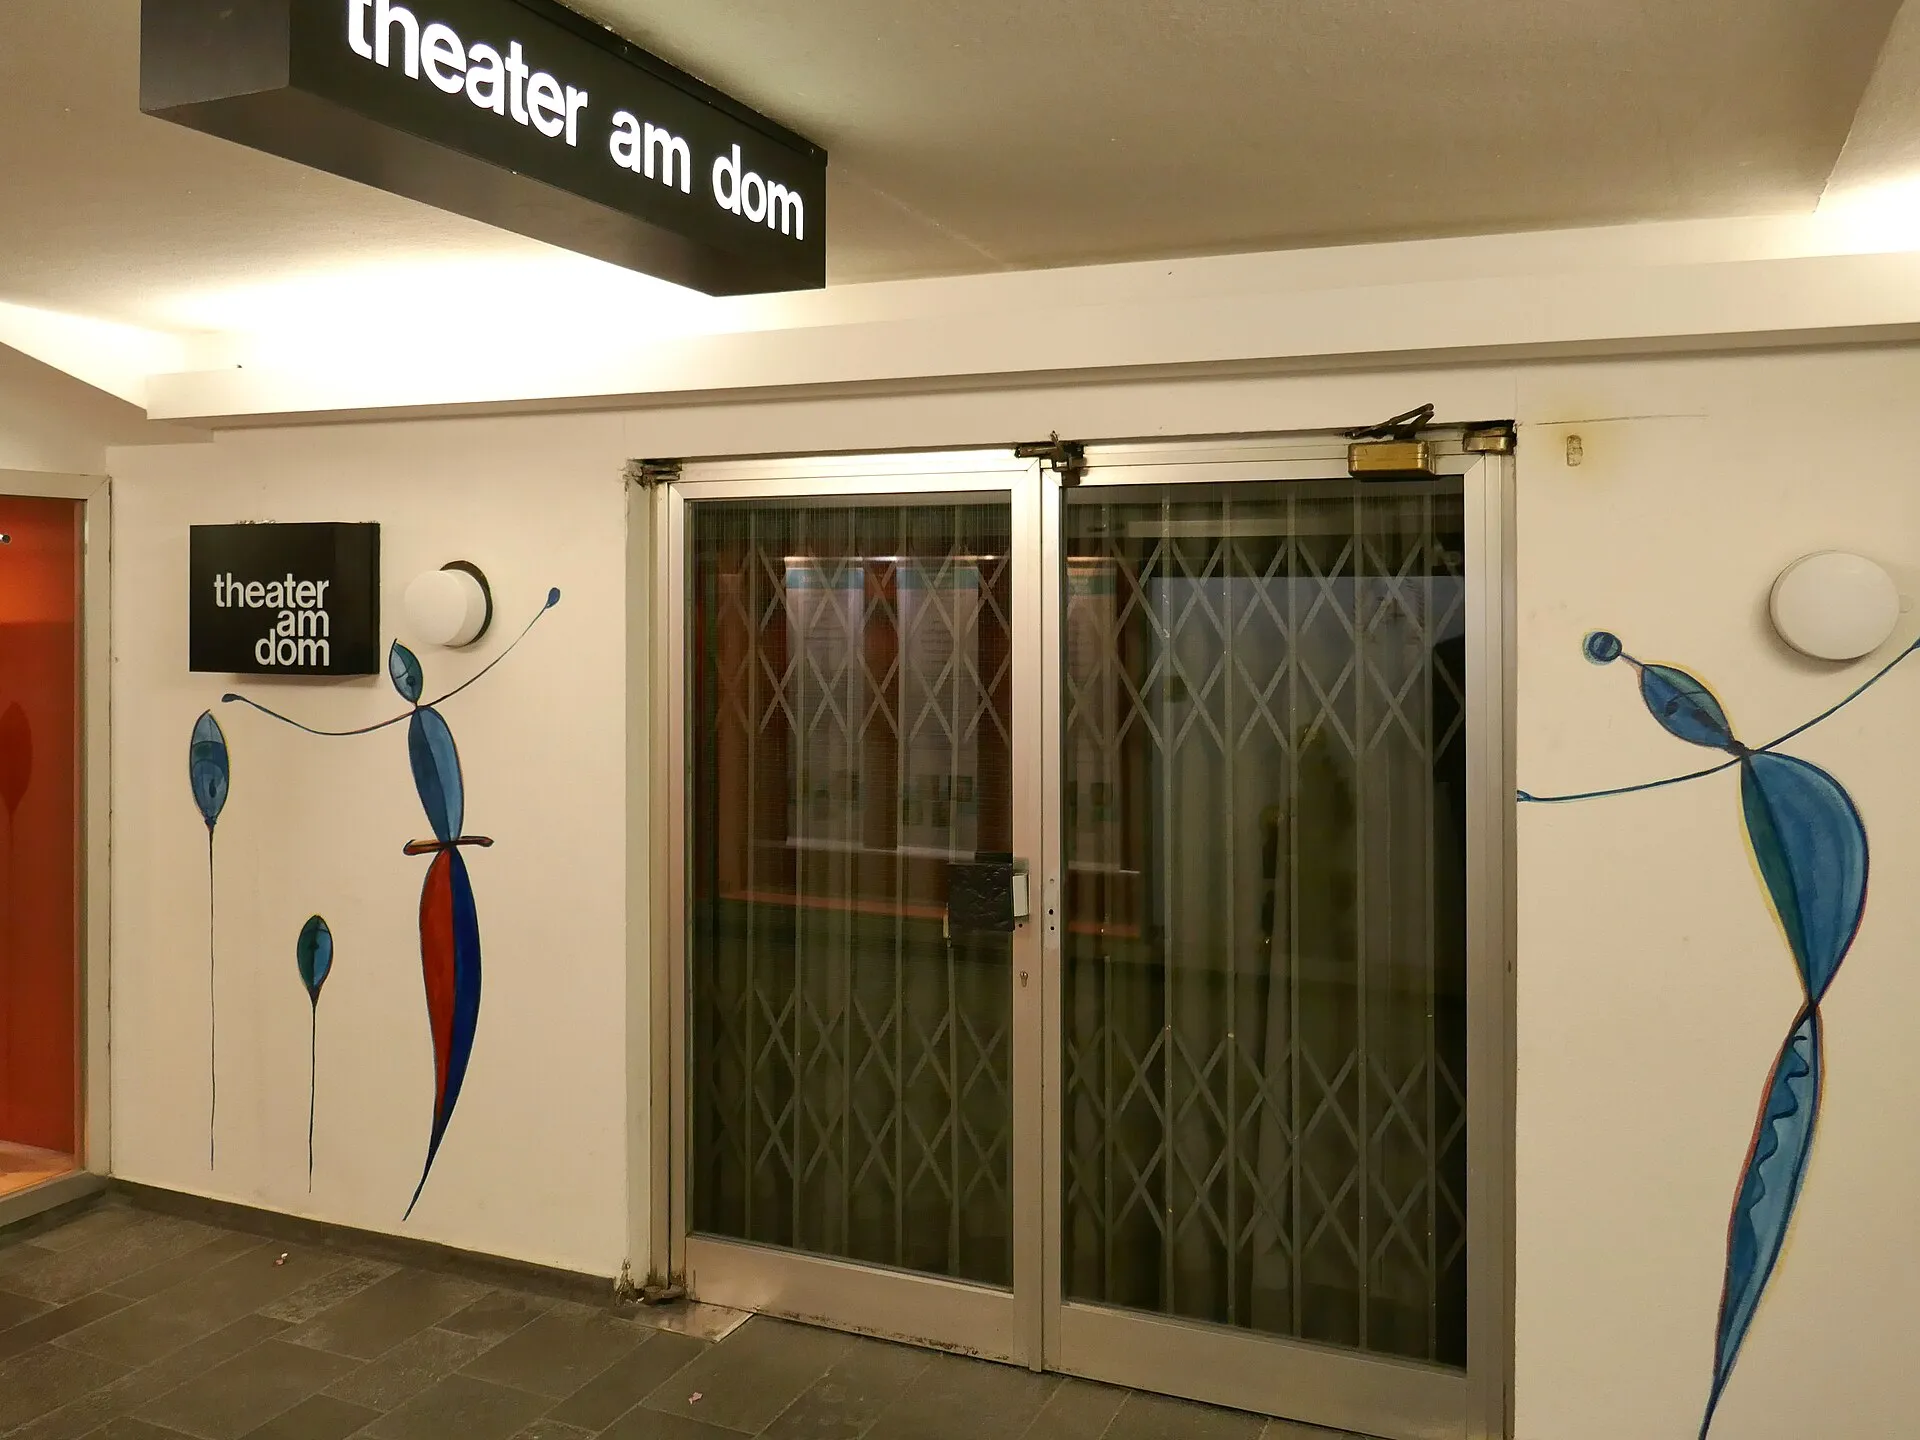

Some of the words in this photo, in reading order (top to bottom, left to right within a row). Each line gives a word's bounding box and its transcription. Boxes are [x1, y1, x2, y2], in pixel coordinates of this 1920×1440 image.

[347, 0, 589, 147] theater
[609, 110, 692, 195] am
[711, 143, 804, 241] dom
[213, 572, 330, 609] theater
[276, 609, 330, 637] am
[254, 628, 330, 667] dom
